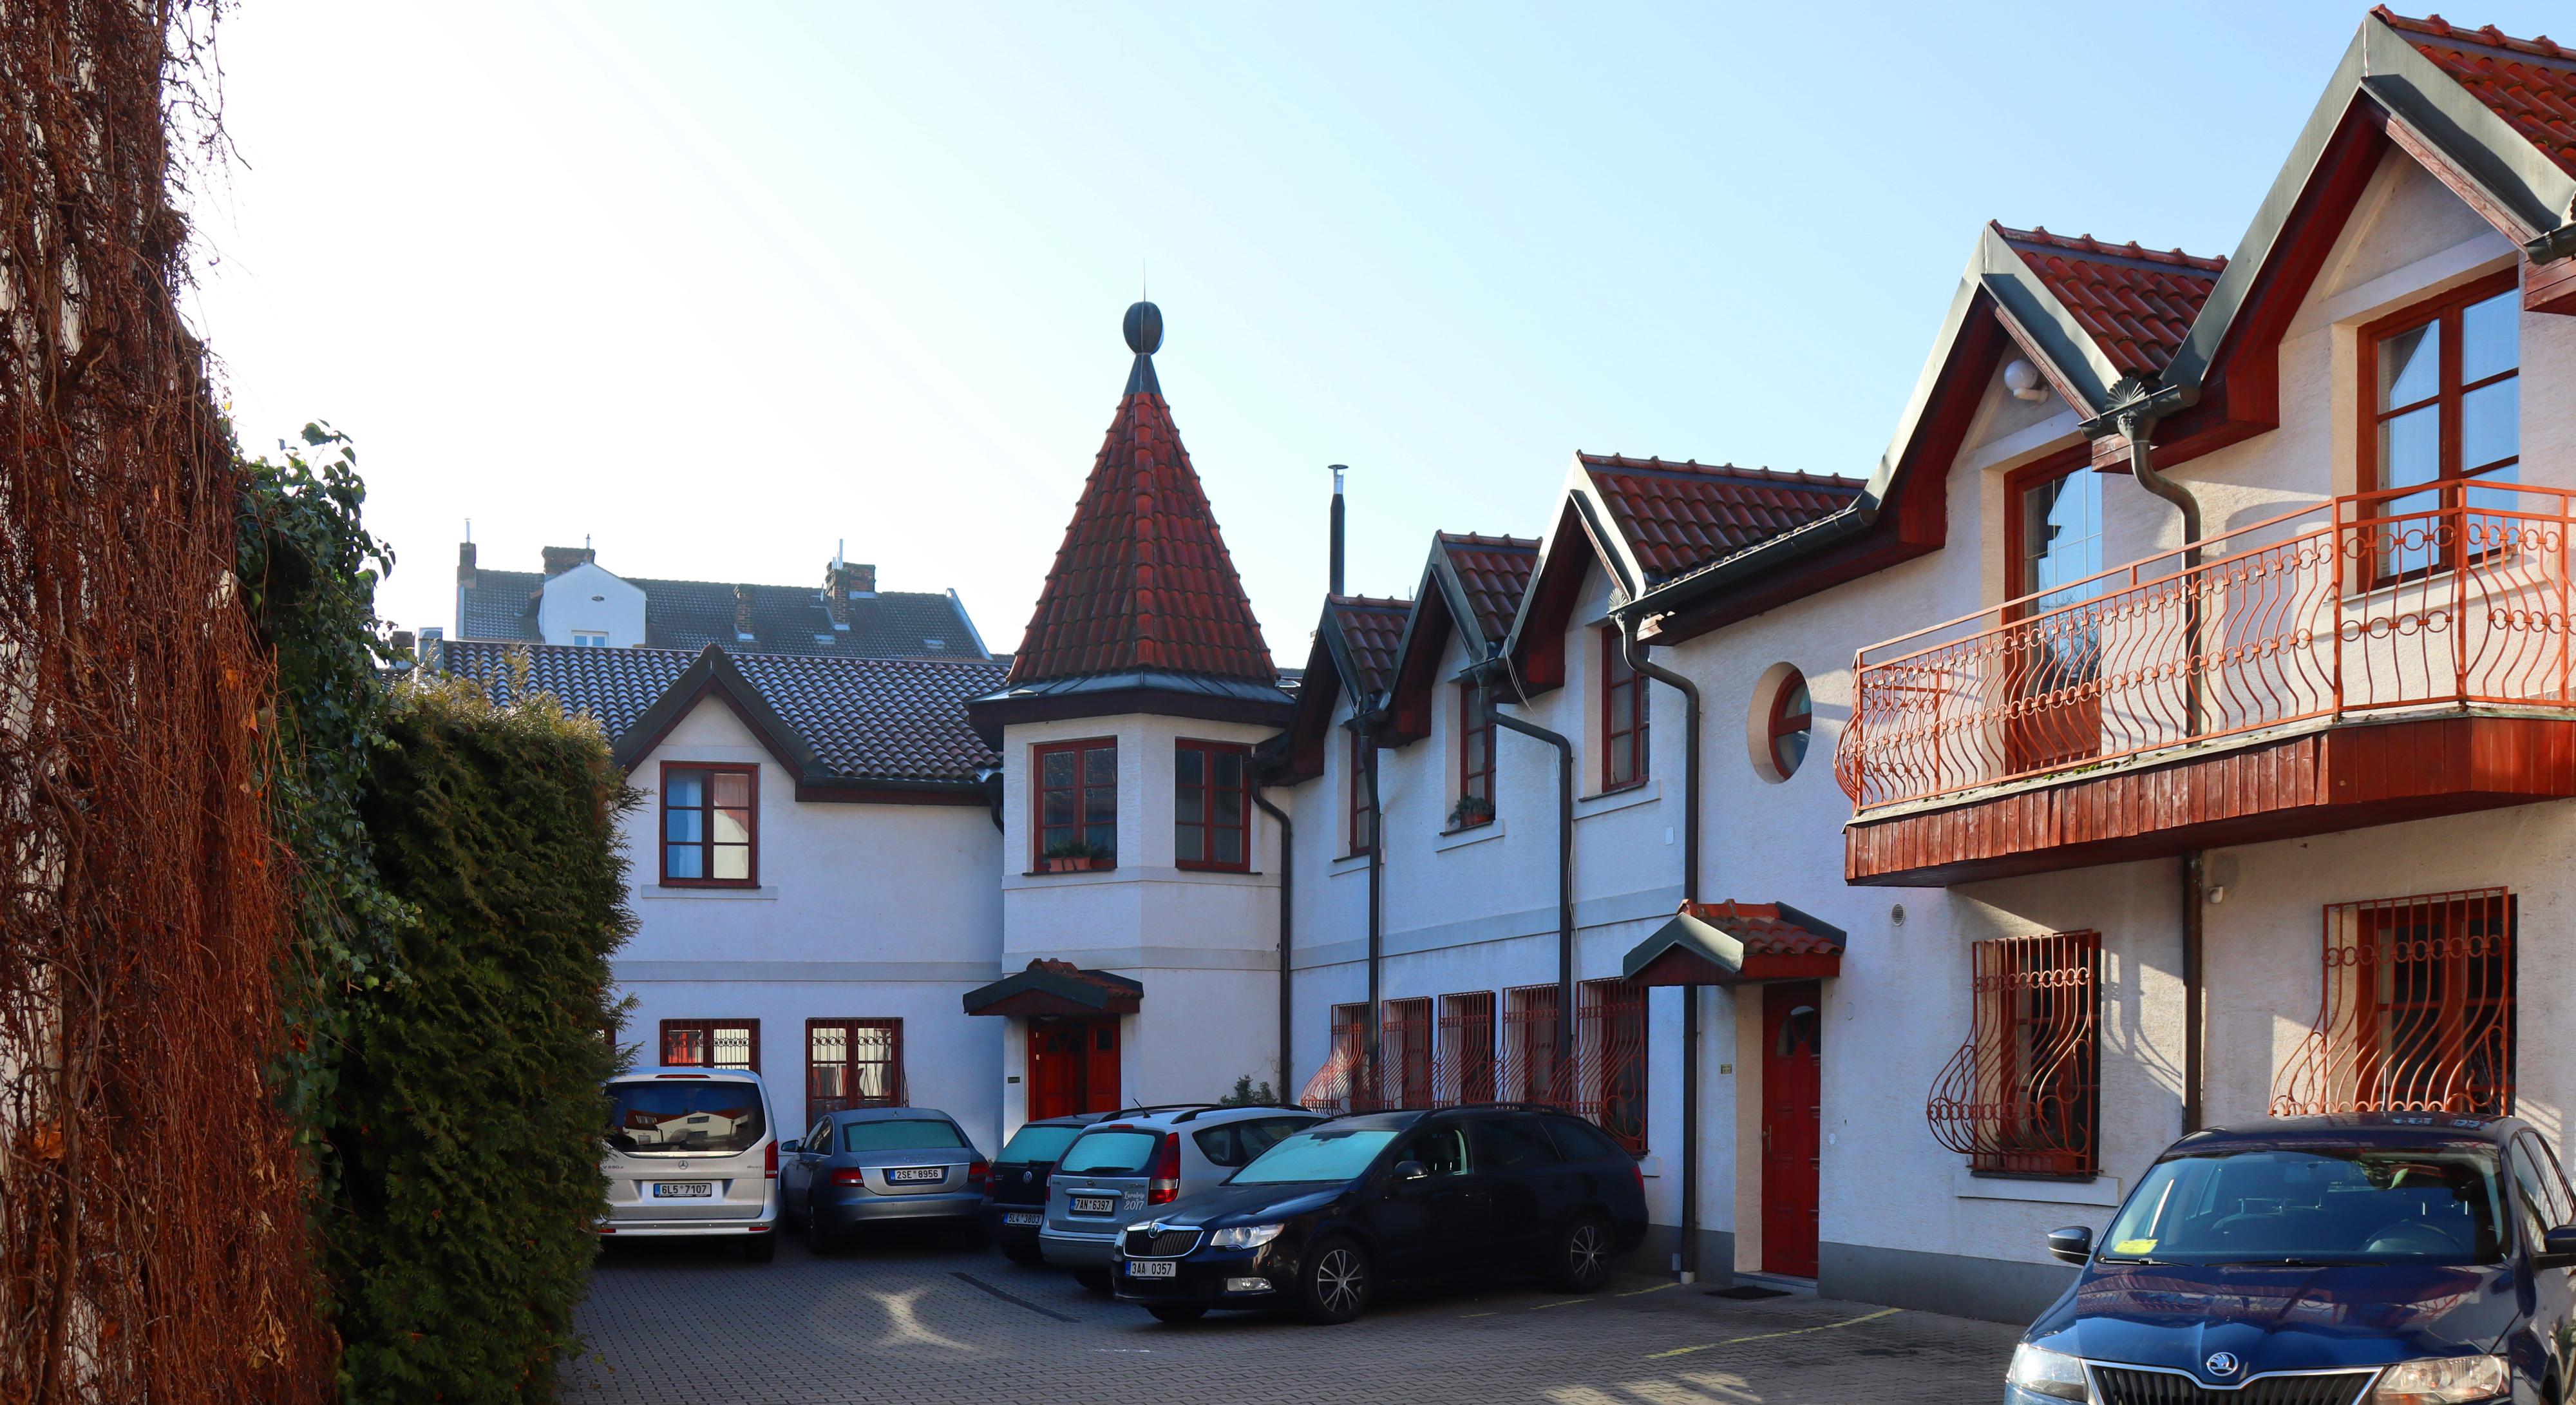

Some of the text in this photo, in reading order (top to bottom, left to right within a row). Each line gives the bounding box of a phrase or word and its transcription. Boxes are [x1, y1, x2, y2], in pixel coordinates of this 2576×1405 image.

[897, 1169, 938, 1179] 2SE 8956
[662, 1185, 707, 1194] 6L5 7107
[1075, 1200, 1110, 1210] 7AN 6397
[1124, 1200, 1144, 1210] 2017
[1132, 1263, 1172, 1275] 3AA 0357
